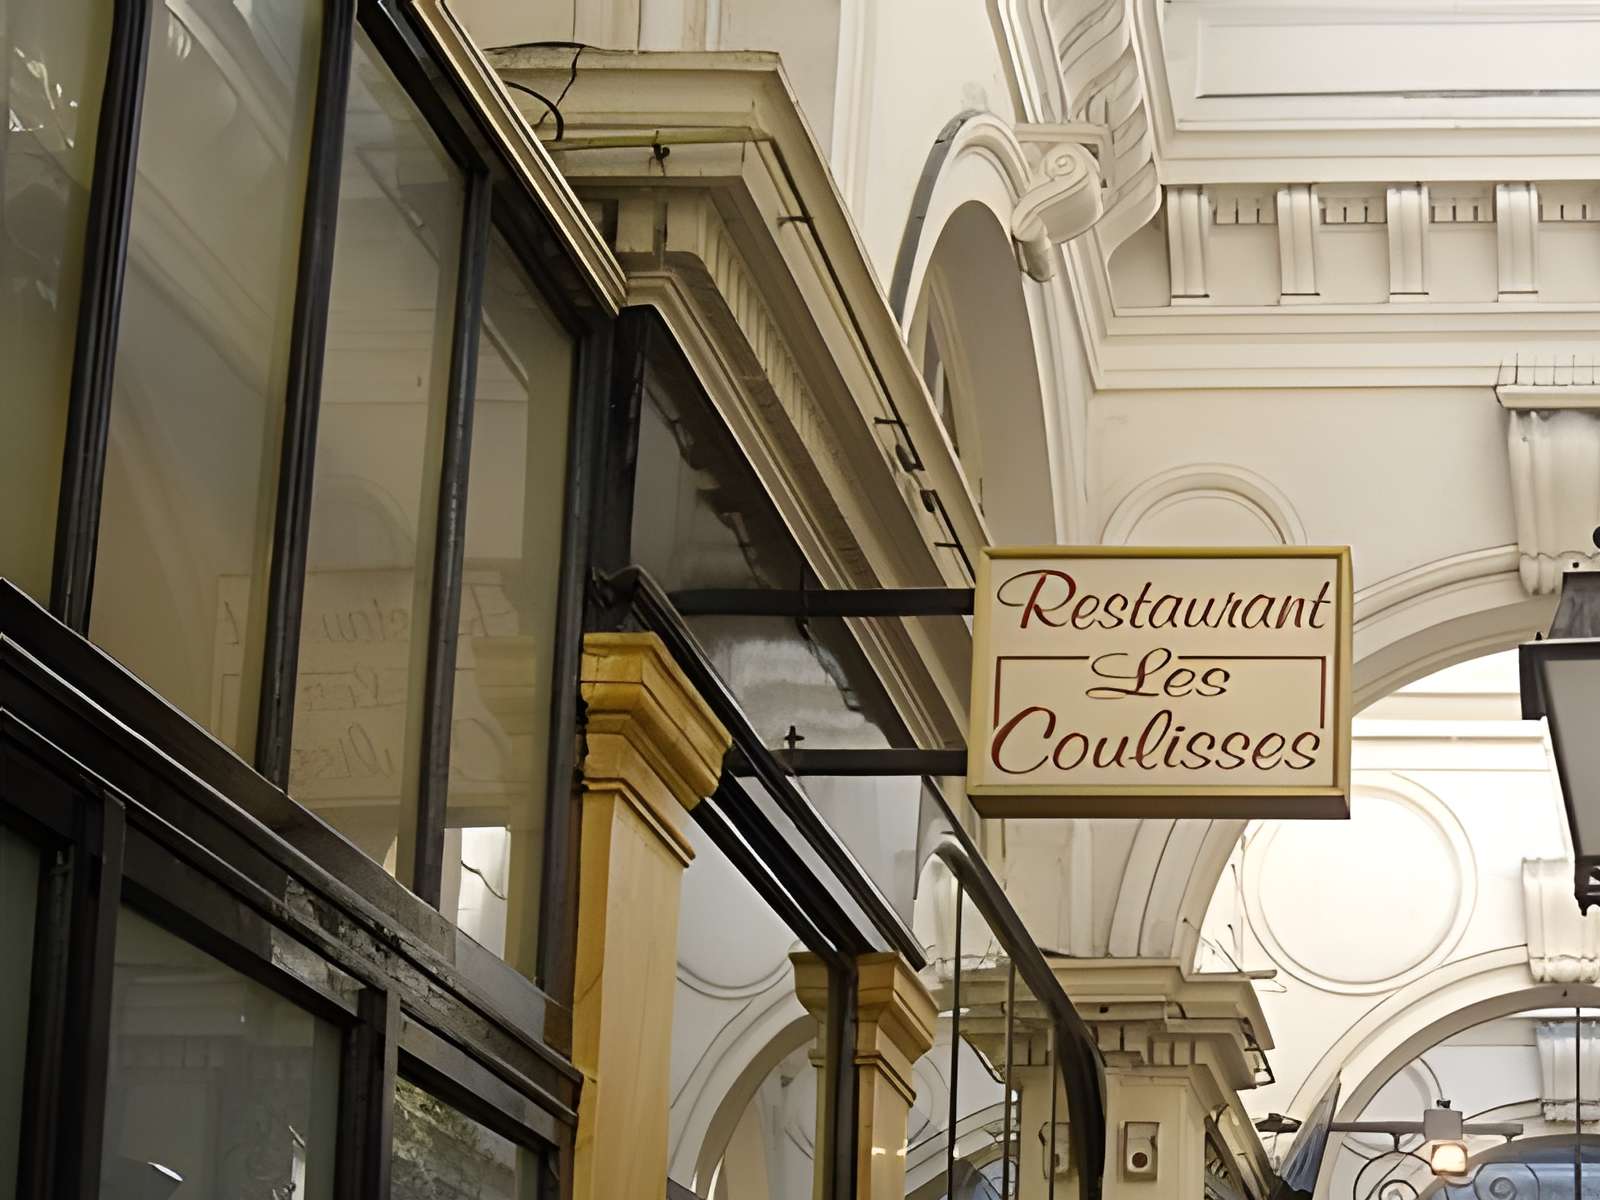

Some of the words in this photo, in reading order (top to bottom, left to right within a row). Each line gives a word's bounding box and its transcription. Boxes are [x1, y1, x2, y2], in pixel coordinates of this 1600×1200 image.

[997, 569, 1332, 630] Restaurant
[1085, 647, 1231, 700] Les
[991, 706, 1321, 775] Coulisses
